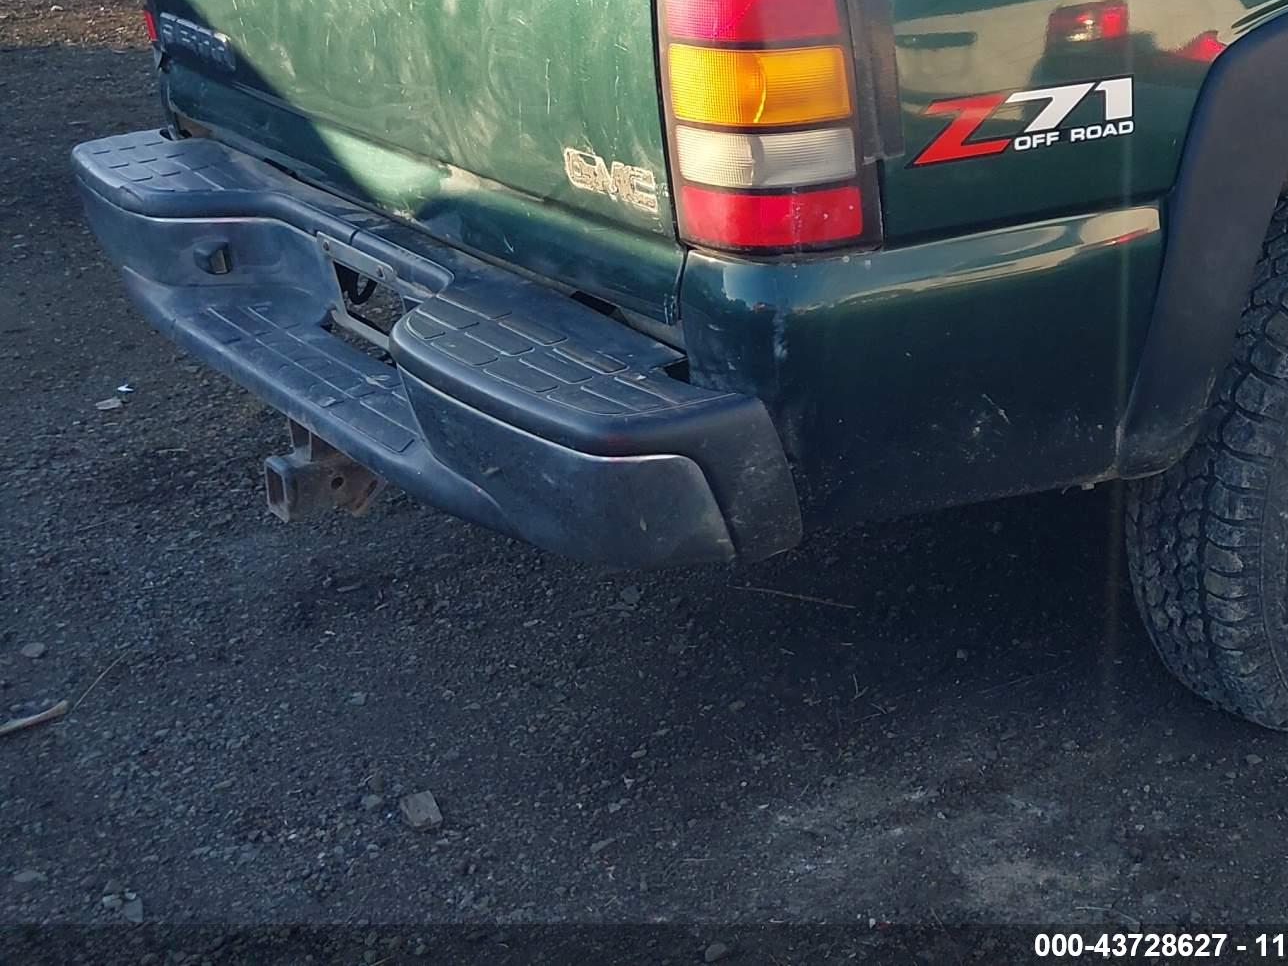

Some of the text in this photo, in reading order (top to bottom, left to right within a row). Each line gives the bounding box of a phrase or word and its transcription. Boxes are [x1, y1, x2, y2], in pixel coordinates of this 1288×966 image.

[910, 76, 1134, 167] Z71
[1013, 120, 1134, 152] OFF ROAD
[564, 147, 658, 212] GMC
